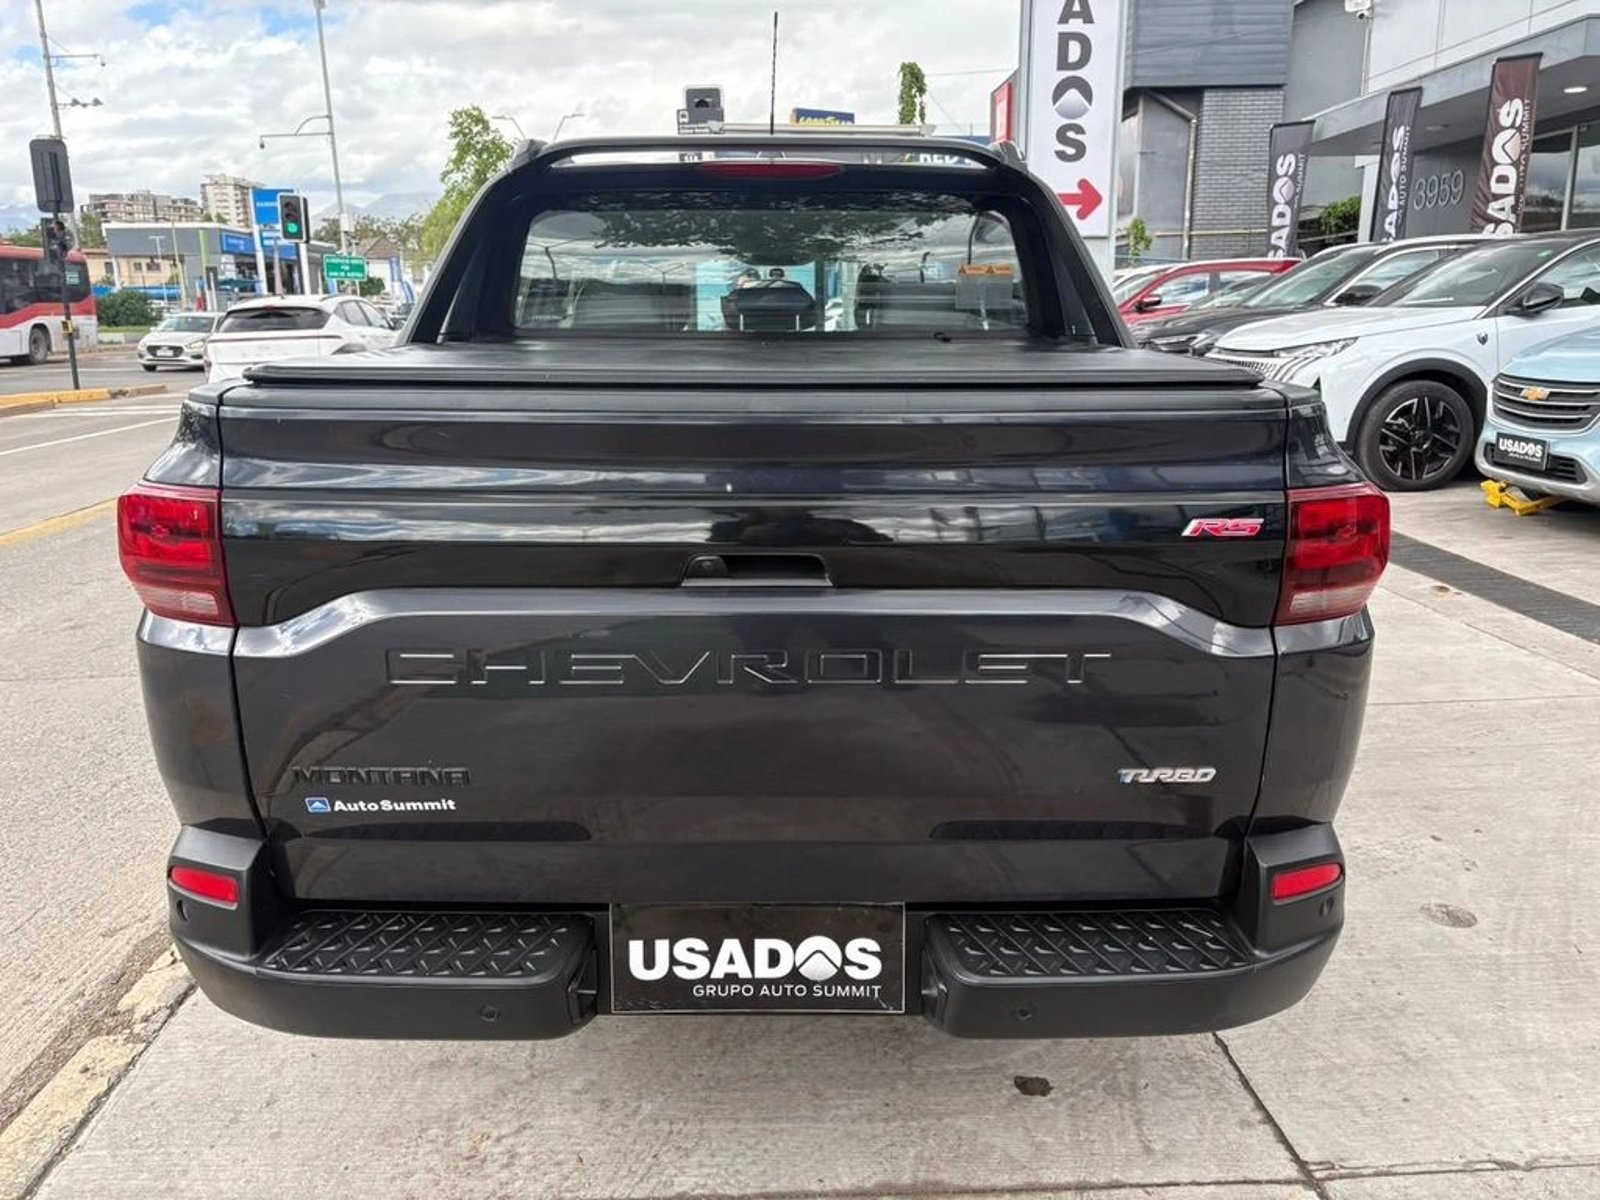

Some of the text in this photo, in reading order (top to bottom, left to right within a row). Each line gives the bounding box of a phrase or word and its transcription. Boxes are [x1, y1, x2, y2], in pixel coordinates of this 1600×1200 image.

[1383, 125, 1405, 241] ADOS
[1398, 175, 1408, 206] AUTO
[1413, 169, 1464, 210] 3959
[1498, 437, 1544, 457] USADOS
[1181, 518, 1264, 536] RS
[386, 648, 1112, 685] CHEVROLET
[289, 766, 471, 785] MONTANA
[1117, 767, 1217, 783] TURBO
[628, 935, 883, 981] USADOS
[692, 984, 882, 998] GRUPO AUTO SUMMIT
